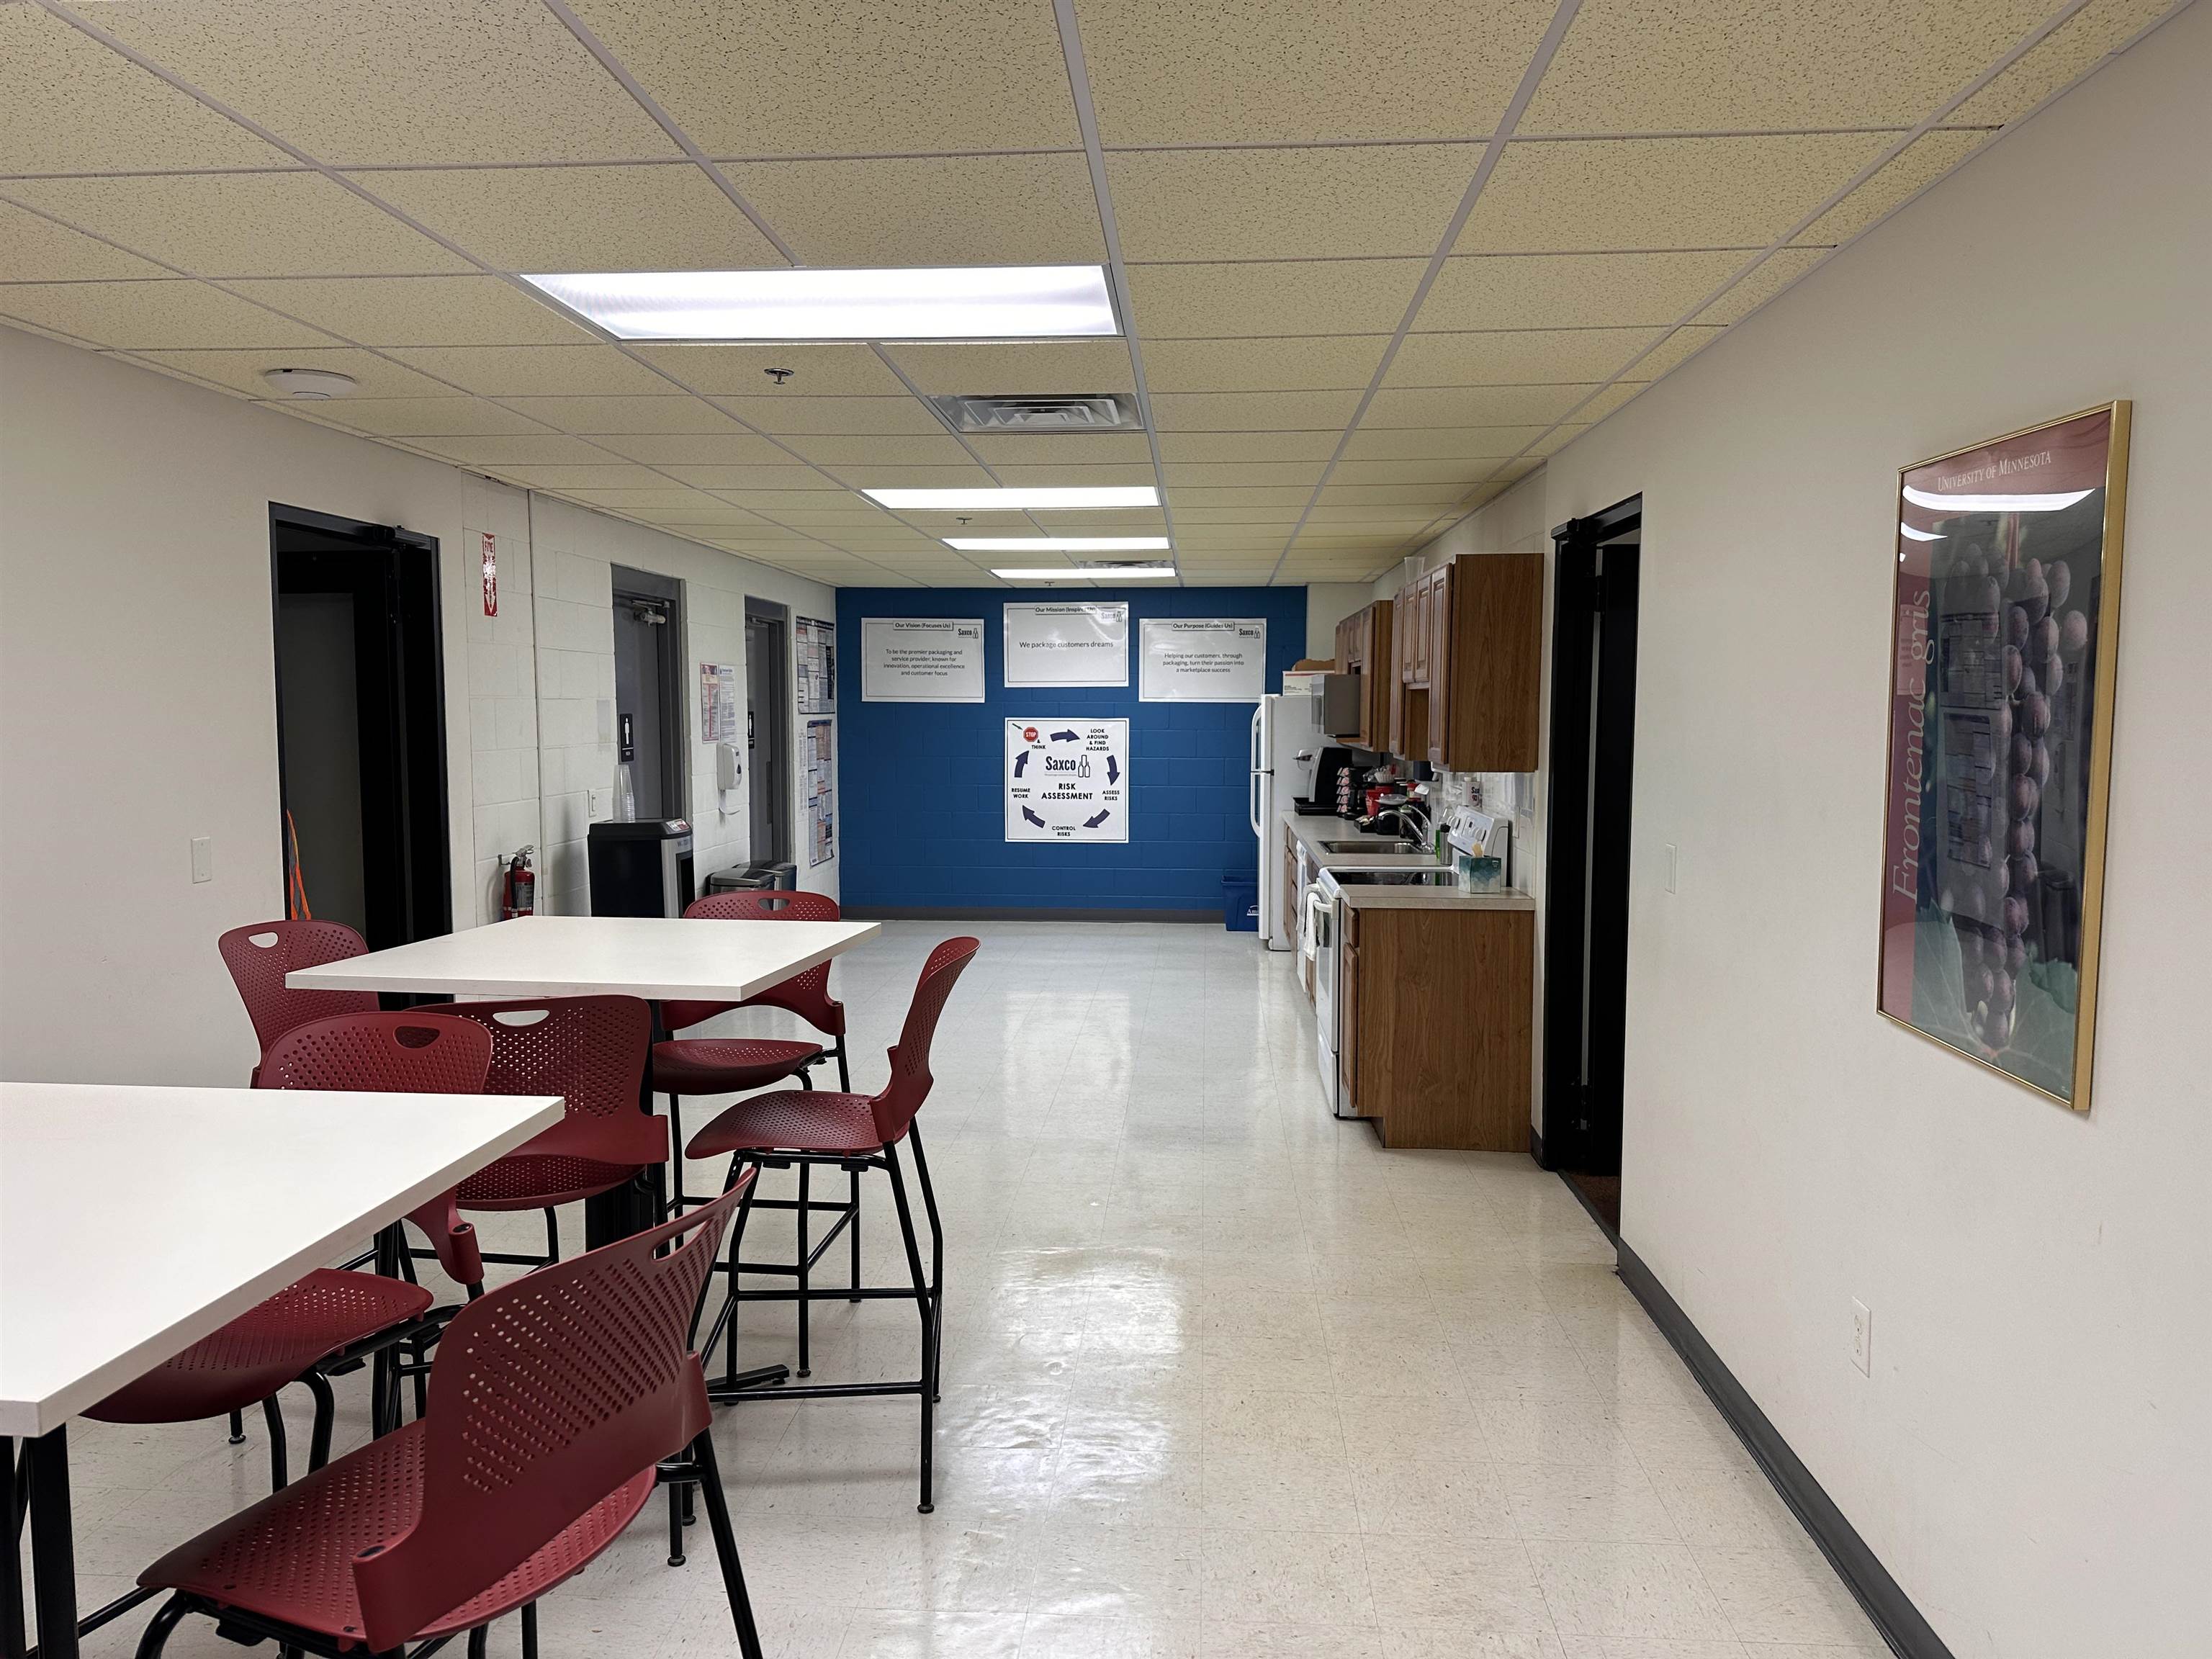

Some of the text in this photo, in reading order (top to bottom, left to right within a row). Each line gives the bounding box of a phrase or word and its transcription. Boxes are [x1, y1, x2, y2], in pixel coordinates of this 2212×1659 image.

[1938, 451, 2051, 491] UNIVERSITY OF MINNESOTA
[958, 628, 972, 637] Saxco
[1238, 628, 1254, 637] Saxco
[1912, 589, 1935, 664] gris
[1031, 641, 1056, 649] package
[1046, 756, 1076, 770] Saxco
[1892, 678, 1925, 903] Frontenac
